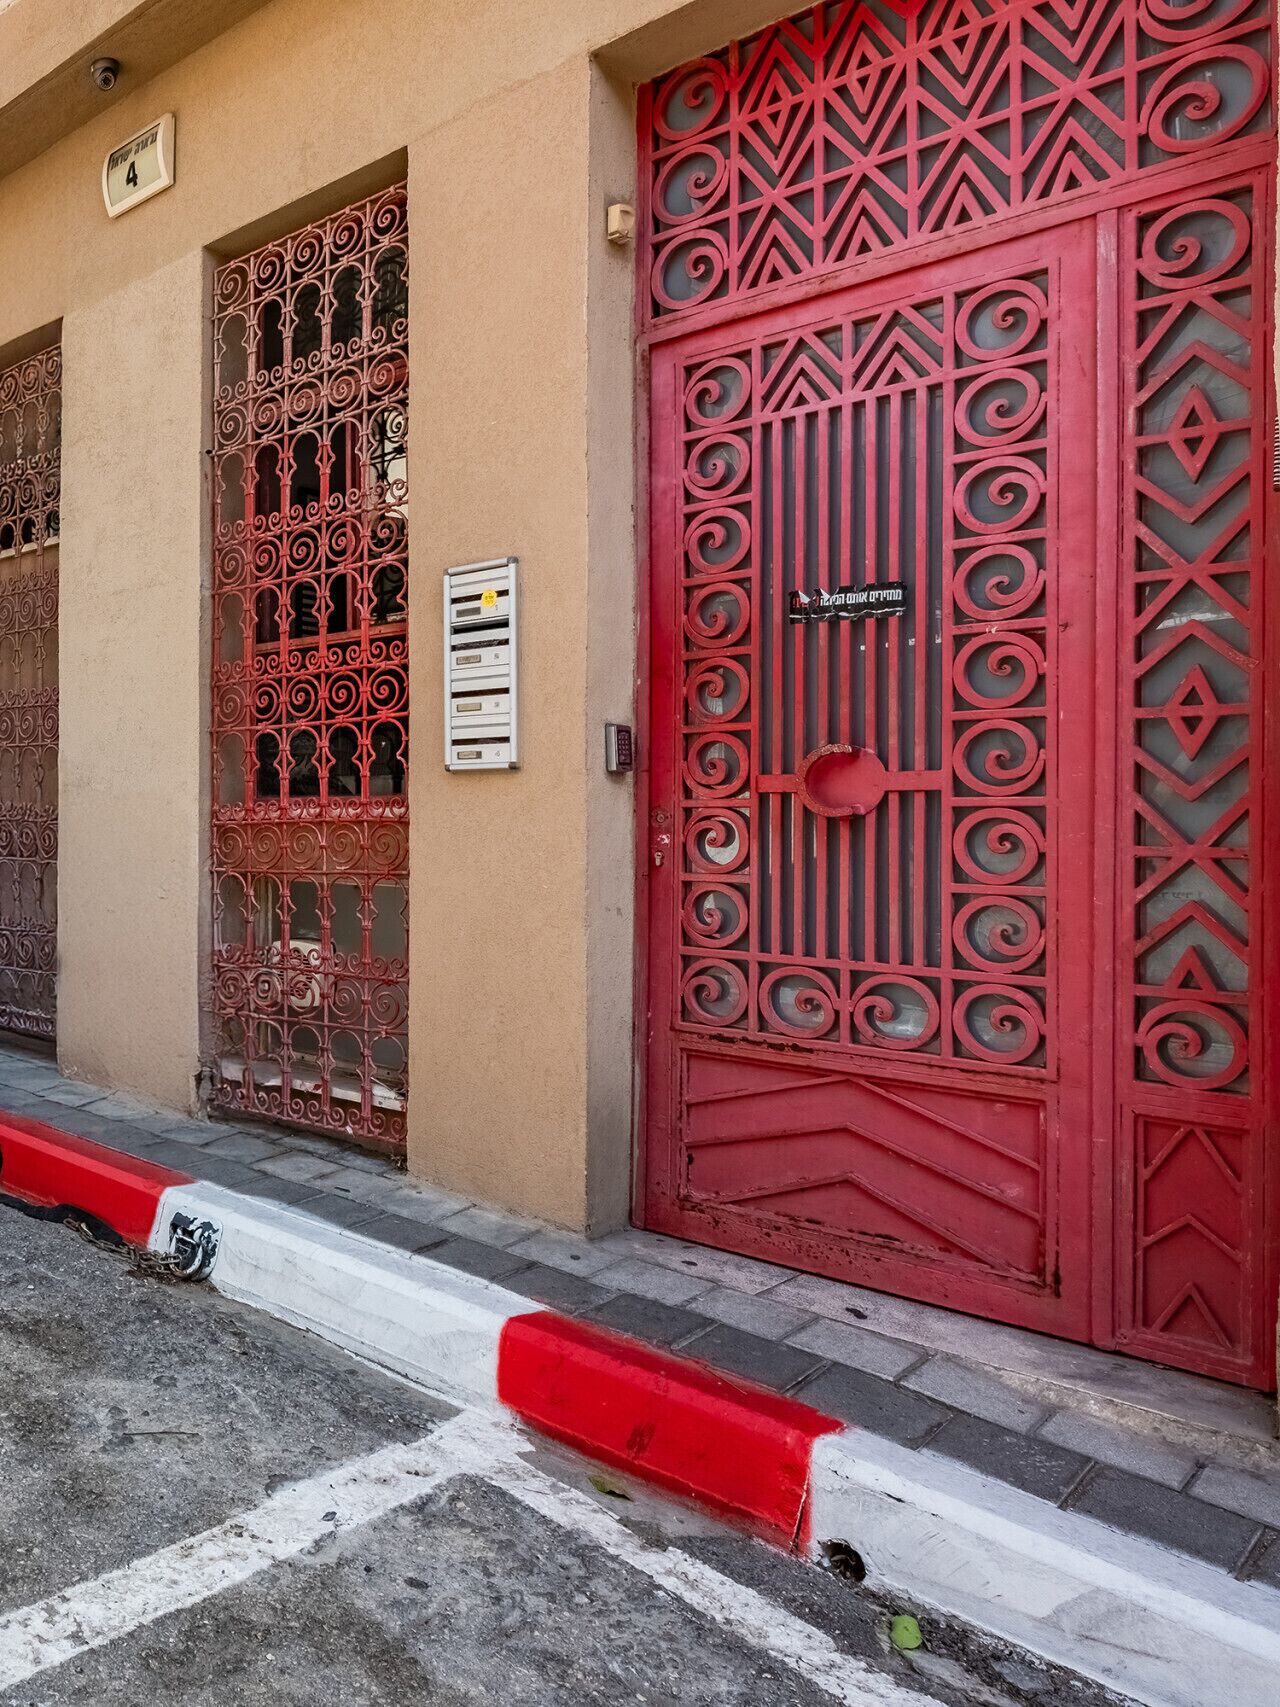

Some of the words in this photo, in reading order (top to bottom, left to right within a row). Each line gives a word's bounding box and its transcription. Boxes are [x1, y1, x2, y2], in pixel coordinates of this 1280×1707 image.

[126, 161, 138, 187] 4
[846, 591, 868, 604] אותם
[869, 589, 902, 602] מחזירים
